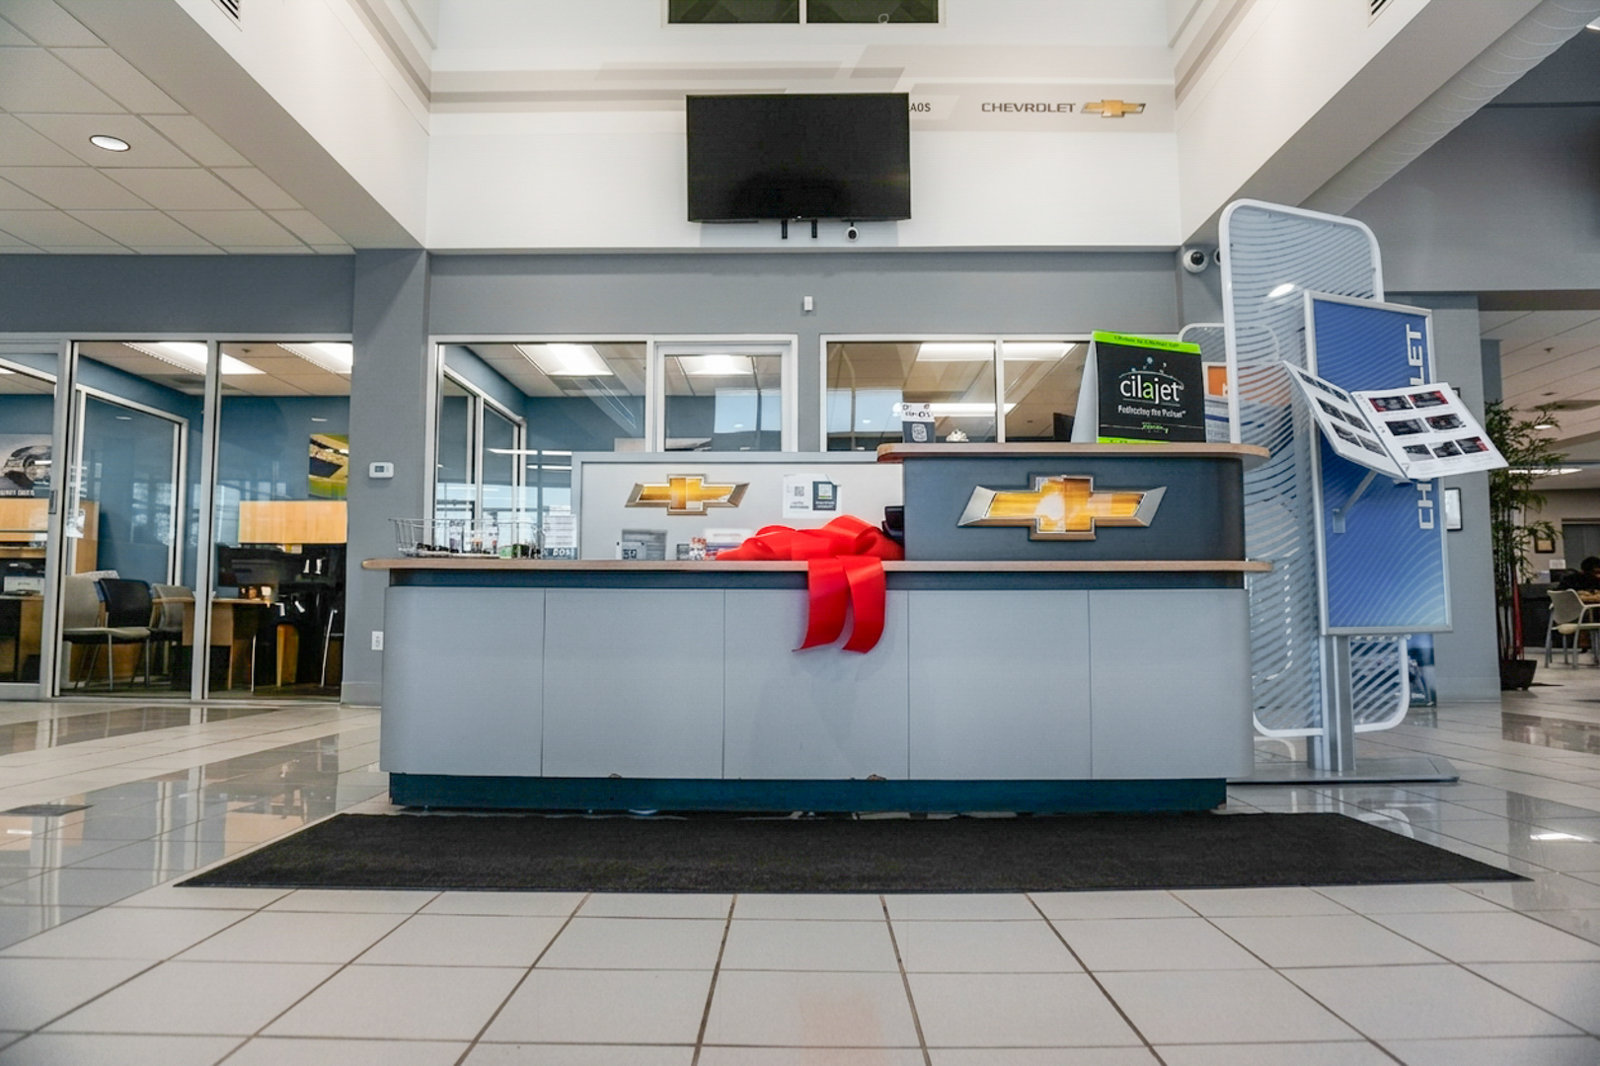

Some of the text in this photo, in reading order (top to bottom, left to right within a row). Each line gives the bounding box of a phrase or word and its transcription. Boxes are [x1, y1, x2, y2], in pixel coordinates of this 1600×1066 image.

[981, 102, 1076, 113] CHEVROLET
[1119, 374, 1181, 404] cilajet
[1405, 323, 1435, 530] CHLET
